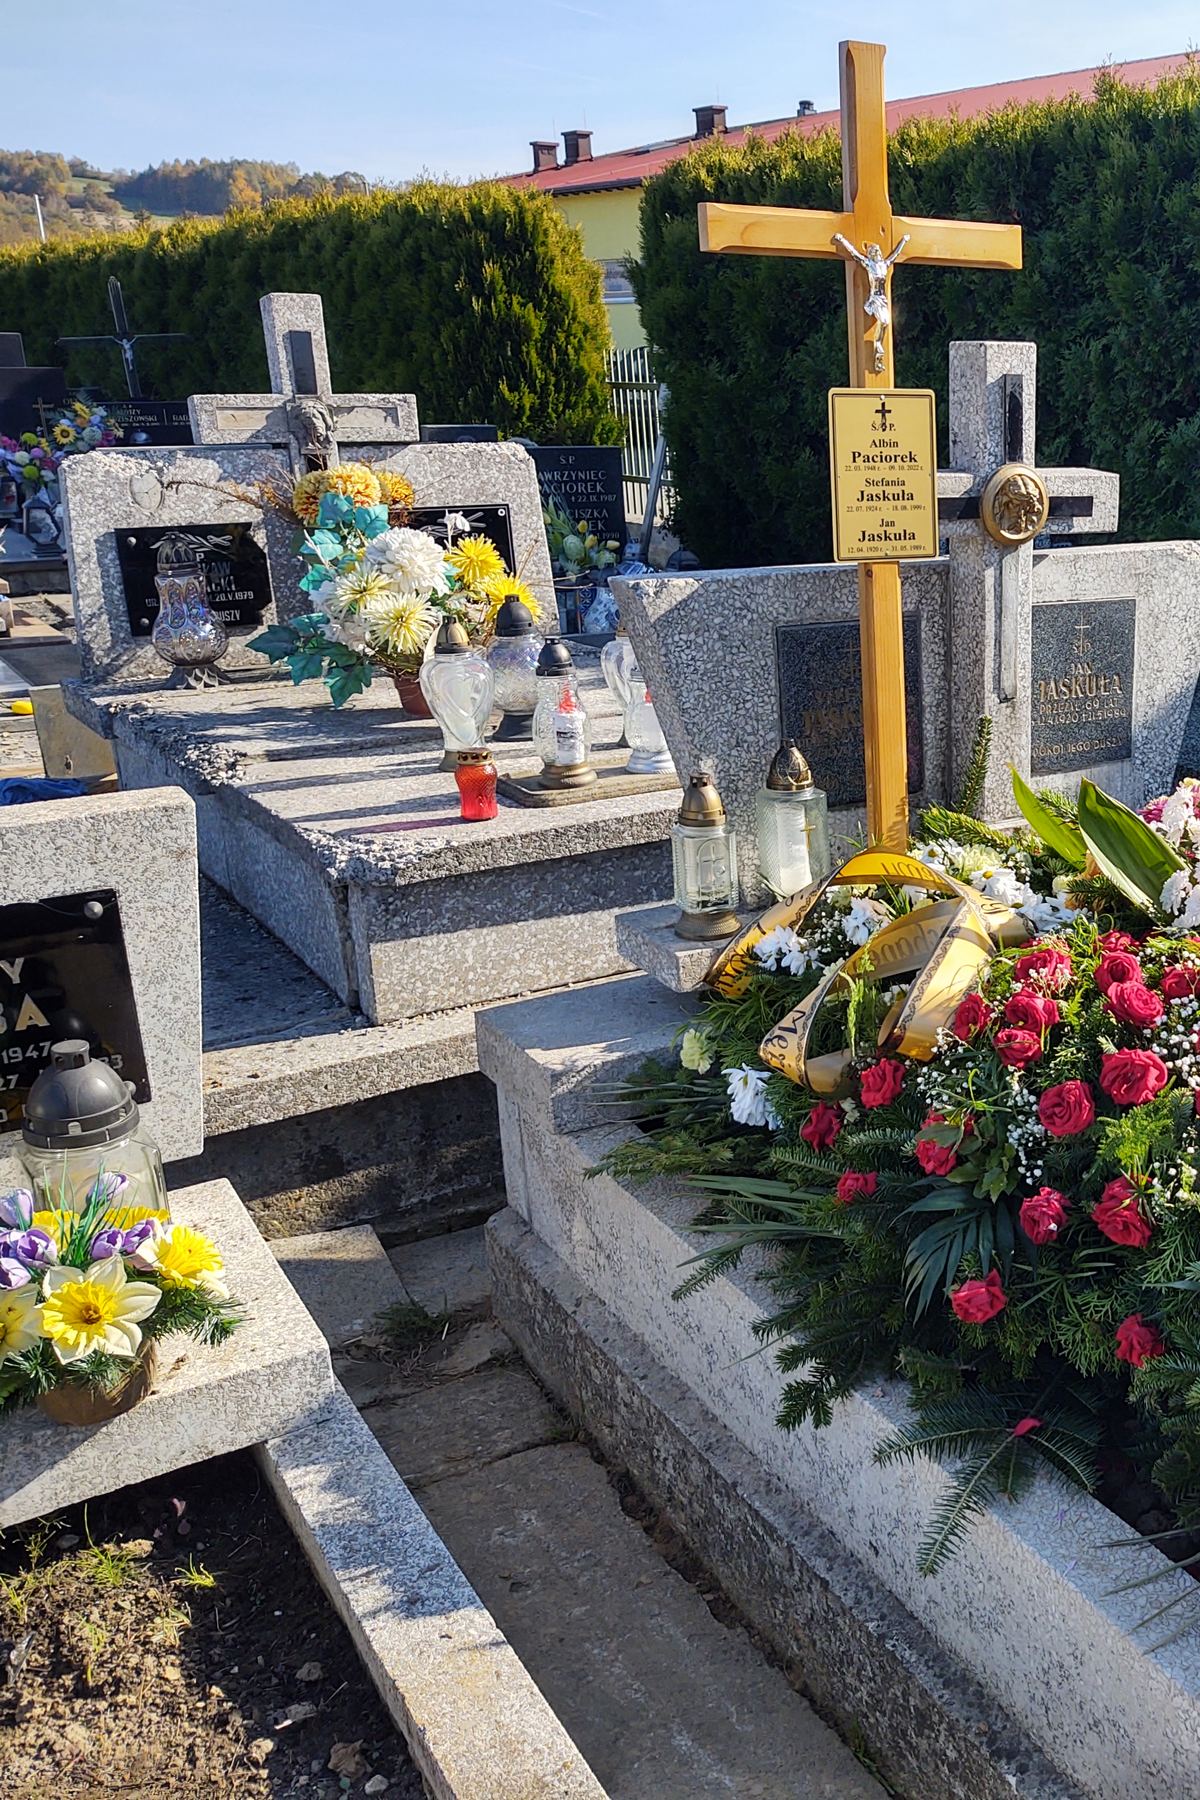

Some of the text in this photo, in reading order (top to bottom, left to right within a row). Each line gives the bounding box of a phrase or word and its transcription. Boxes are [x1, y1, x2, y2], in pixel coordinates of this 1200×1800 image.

[870, 438, 899, 448] Albin
[851, 451, 918, 464] Paciorek
[538, 470, 608, 480] AWRZYNIEC
[865, 477, 906, 488] Stefania
[857, 489, 914, 502] Jaskuła
[879, 518, 896, 528] Jan
[858, 529, 916, 542] Jaskuła
[1072, 662, 1093, 675] JAN
[1039, 673, 1124, 703] JASKUŁA
